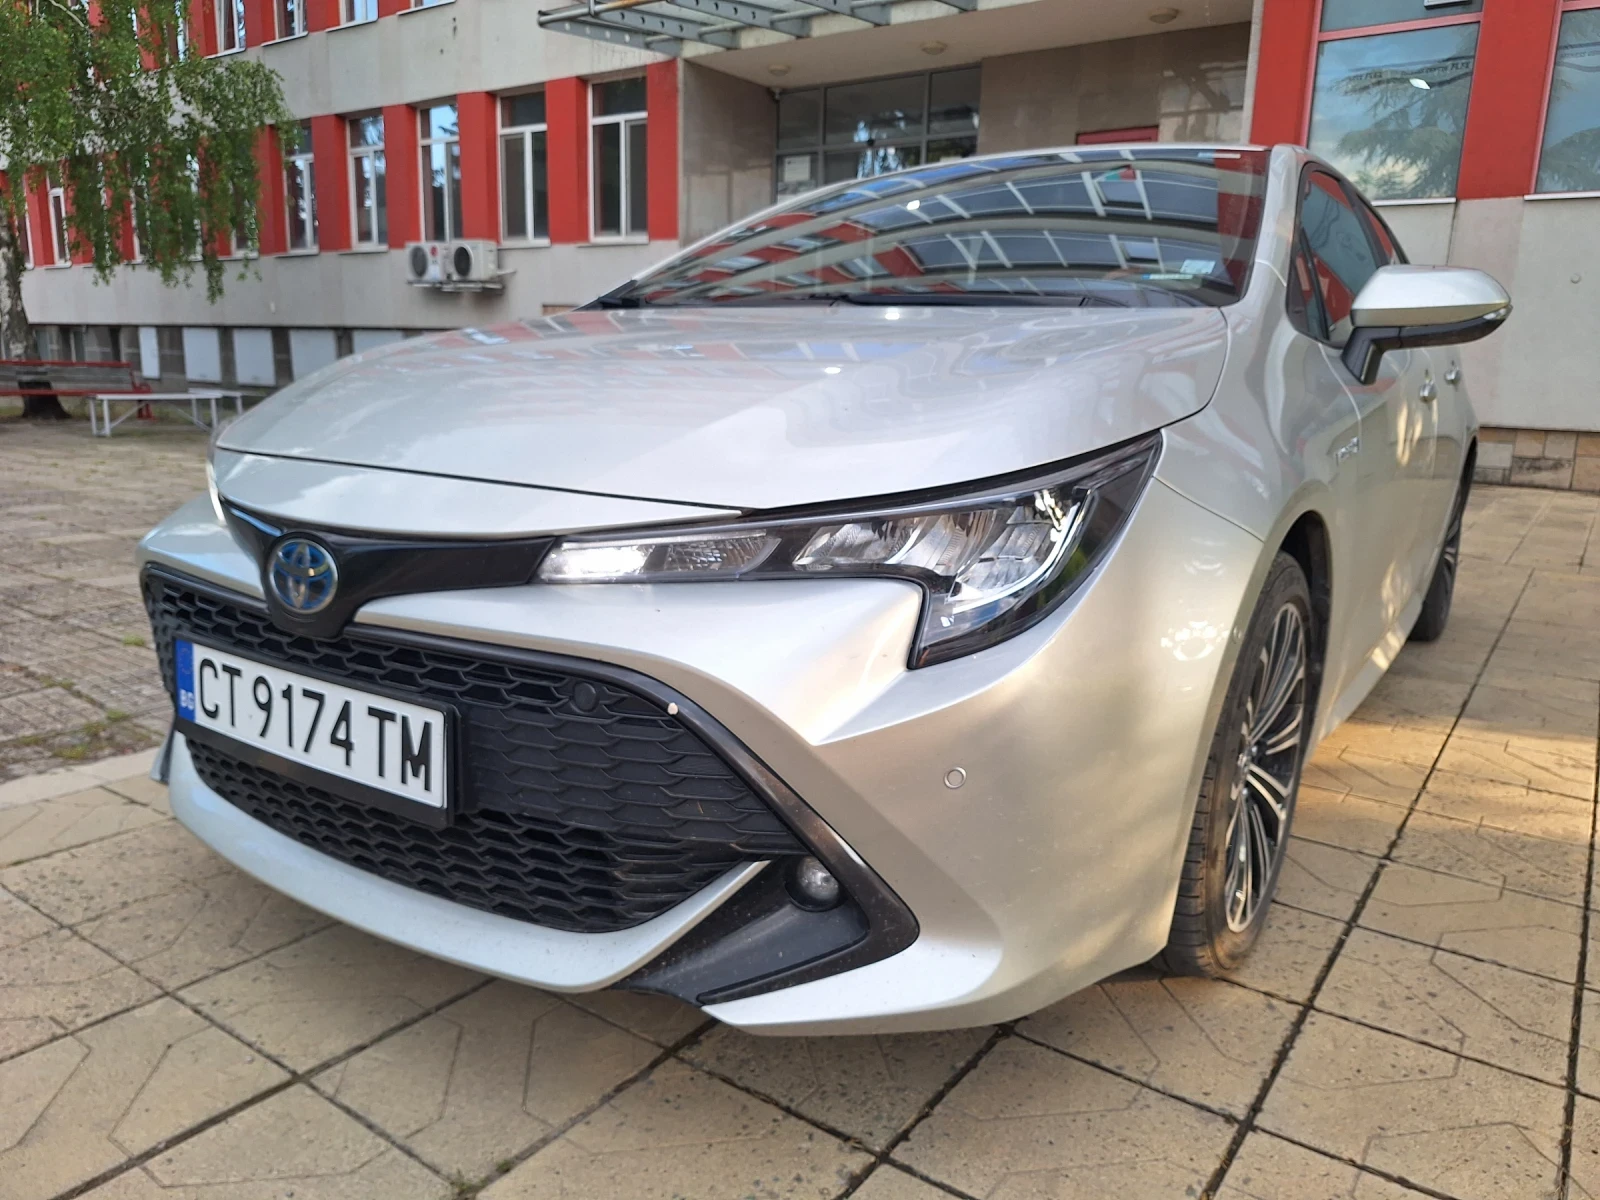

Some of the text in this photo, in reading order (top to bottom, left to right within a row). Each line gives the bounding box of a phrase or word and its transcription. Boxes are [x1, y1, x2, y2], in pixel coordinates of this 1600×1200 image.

[200, 658, 433, 792] CT 9174 TM
